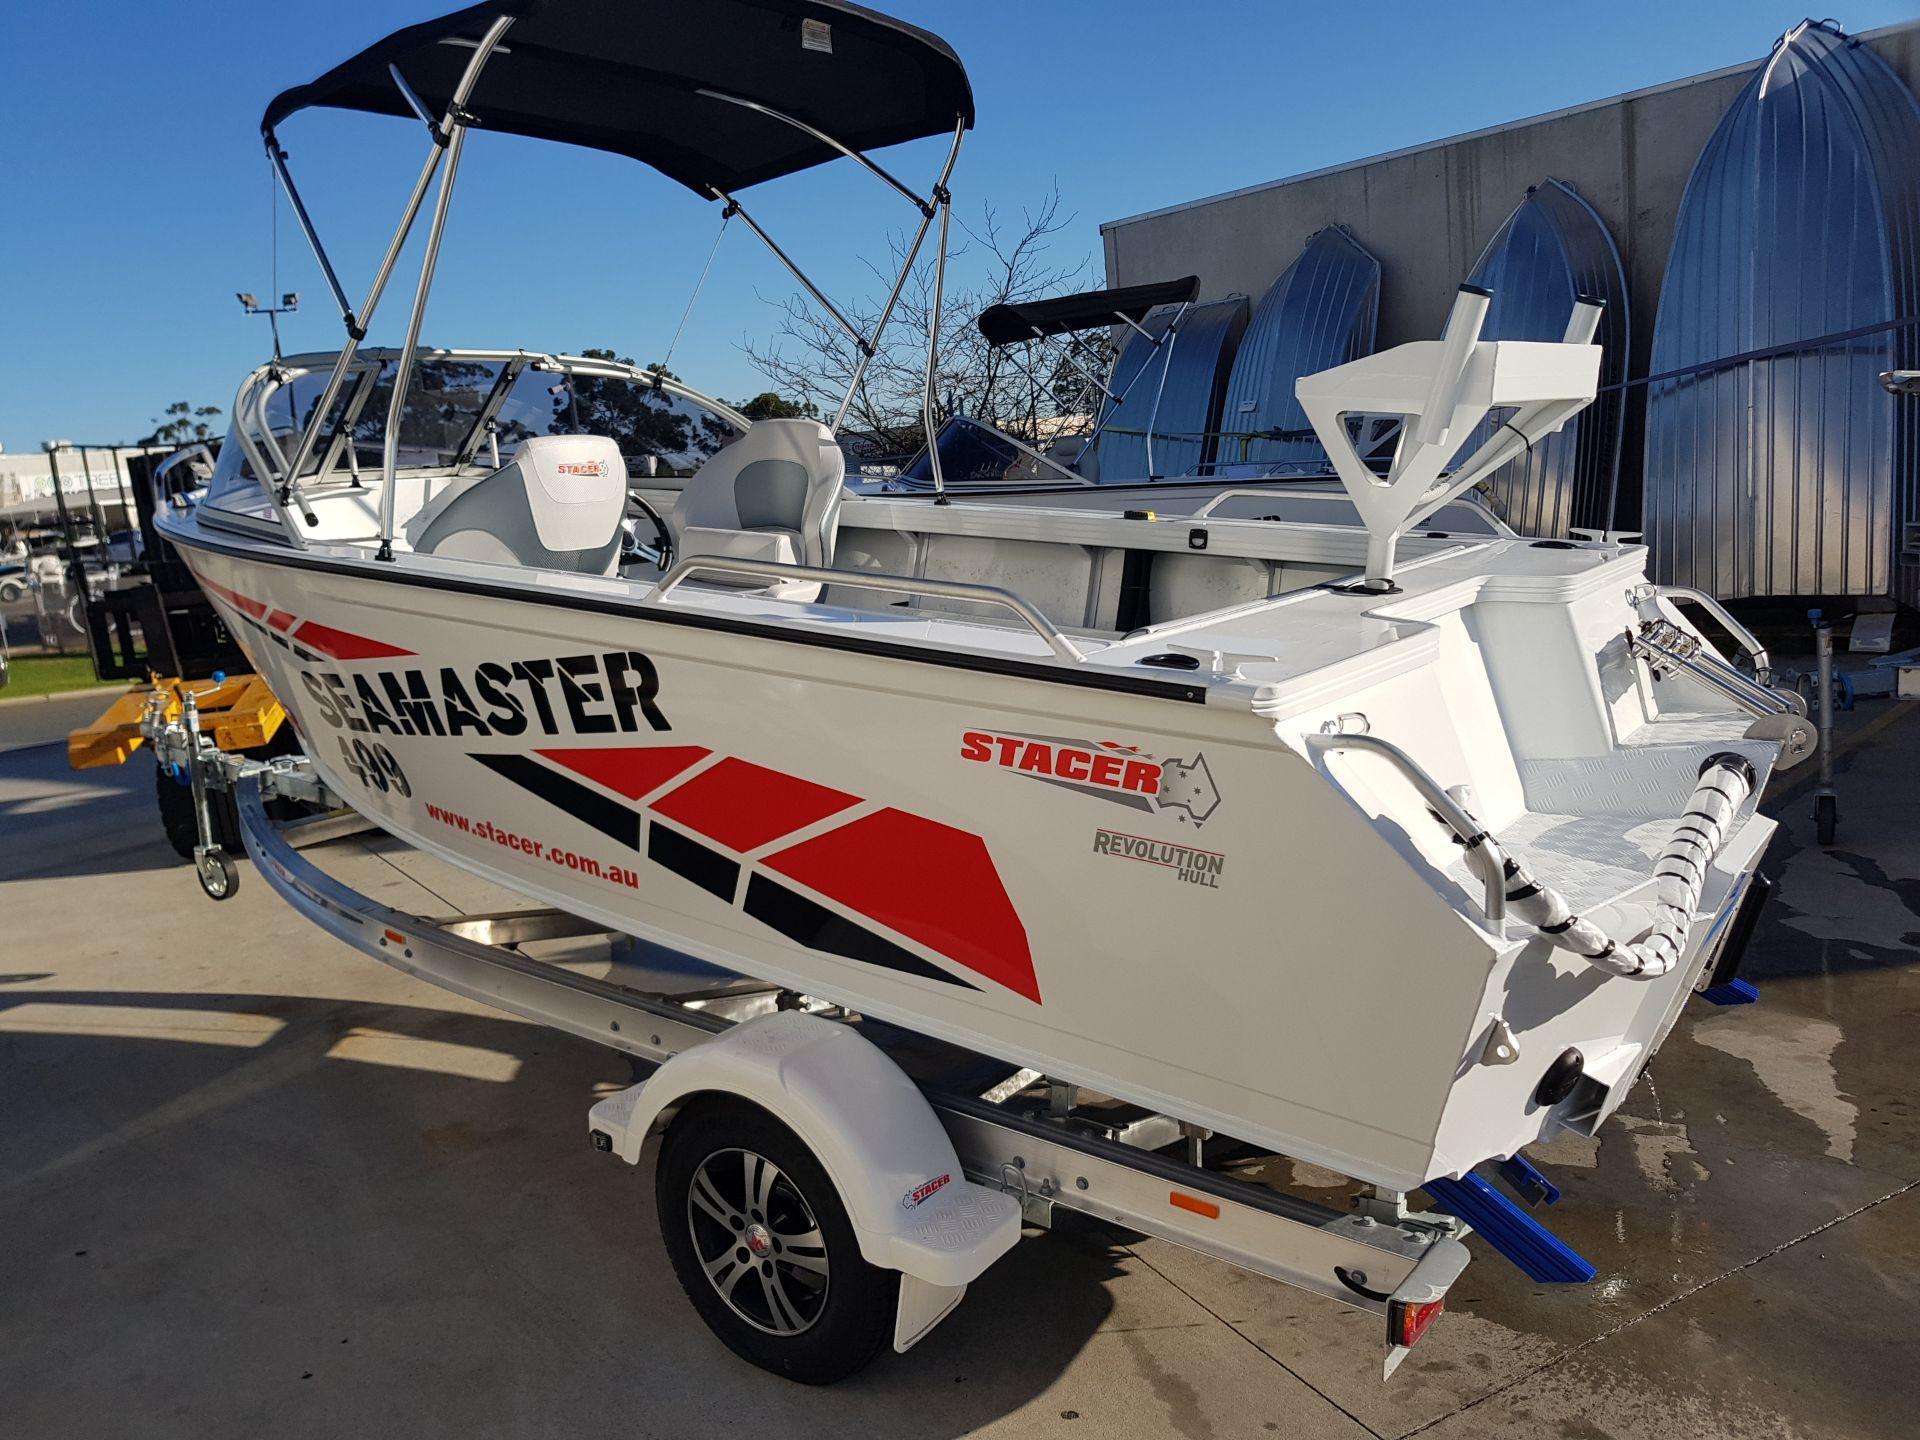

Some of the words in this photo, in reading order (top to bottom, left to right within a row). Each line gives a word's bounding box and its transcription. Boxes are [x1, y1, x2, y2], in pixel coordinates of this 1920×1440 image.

[558, 464, 600, 474] STACER
[301, 652, 672, 736] SEAMASTER
[337, 735, 411, 798] 499
[960, 731, 1162, 794] STACER
[425, 802, 639, 889] www.stacer.com.au
[1093, 831, 1225, 875] REVOLUTION
[1177, 867, 1220, 889] HULL
[912, 1174, 950, 1201] STACER
